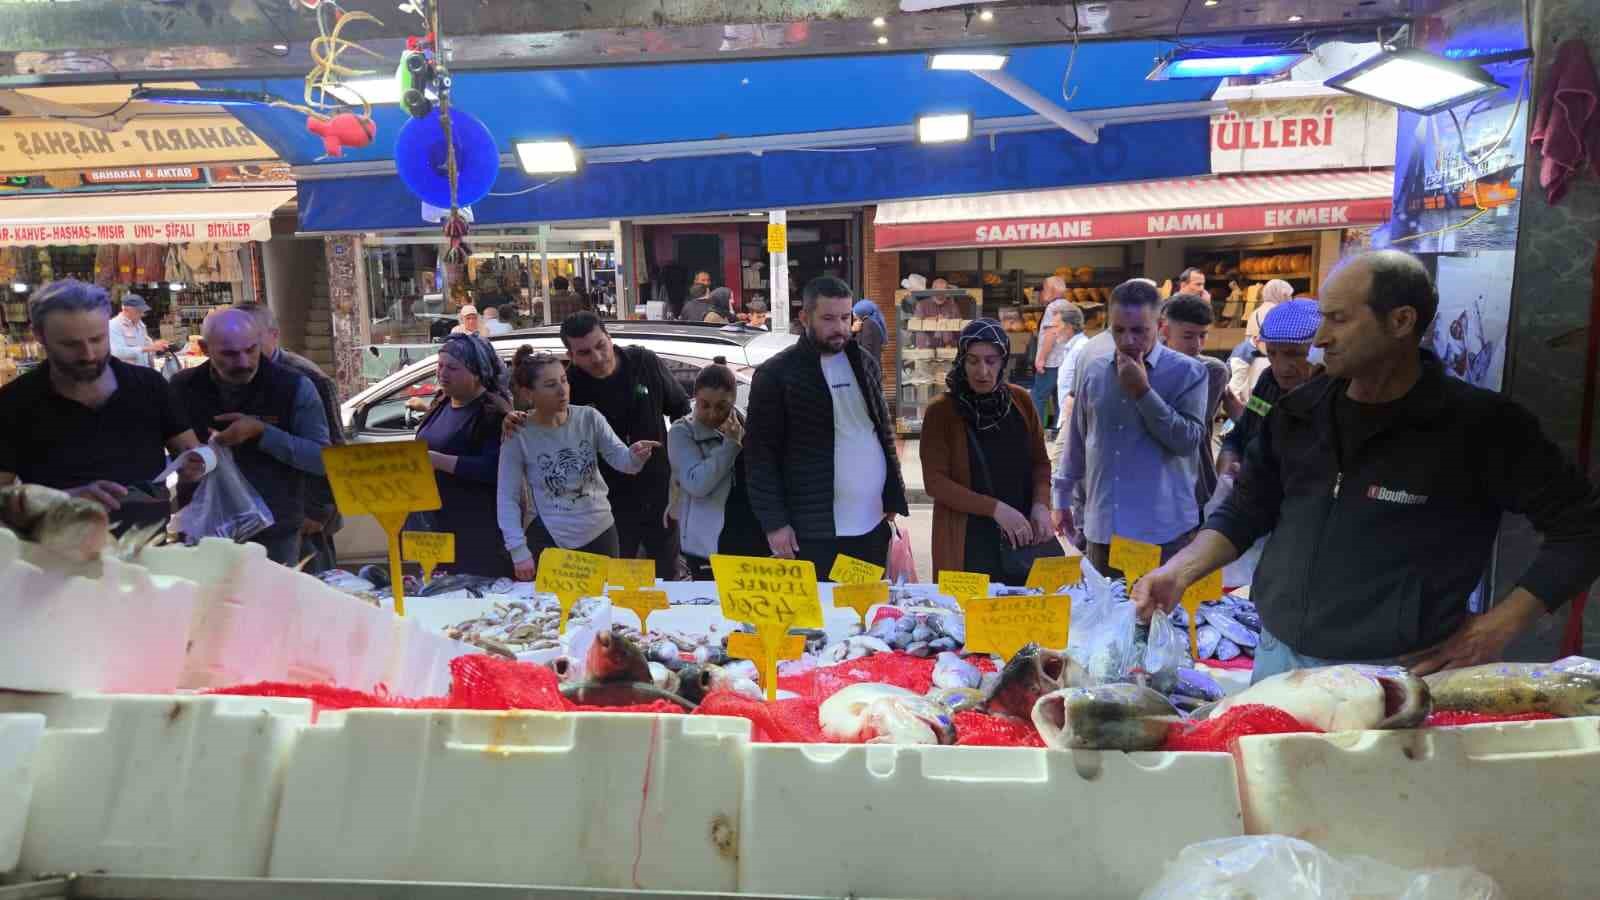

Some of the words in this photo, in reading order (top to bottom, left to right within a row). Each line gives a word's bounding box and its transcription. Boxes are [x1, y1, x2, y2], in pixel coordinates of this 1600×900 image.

[1210, 107, 1334, 150] ÜLLERİ
[975, 219, 1094, 243] SAATHANE
[1147, 211, 1225, 233] NAMLI
[1263, 205, 1350, 227] EKMEK
